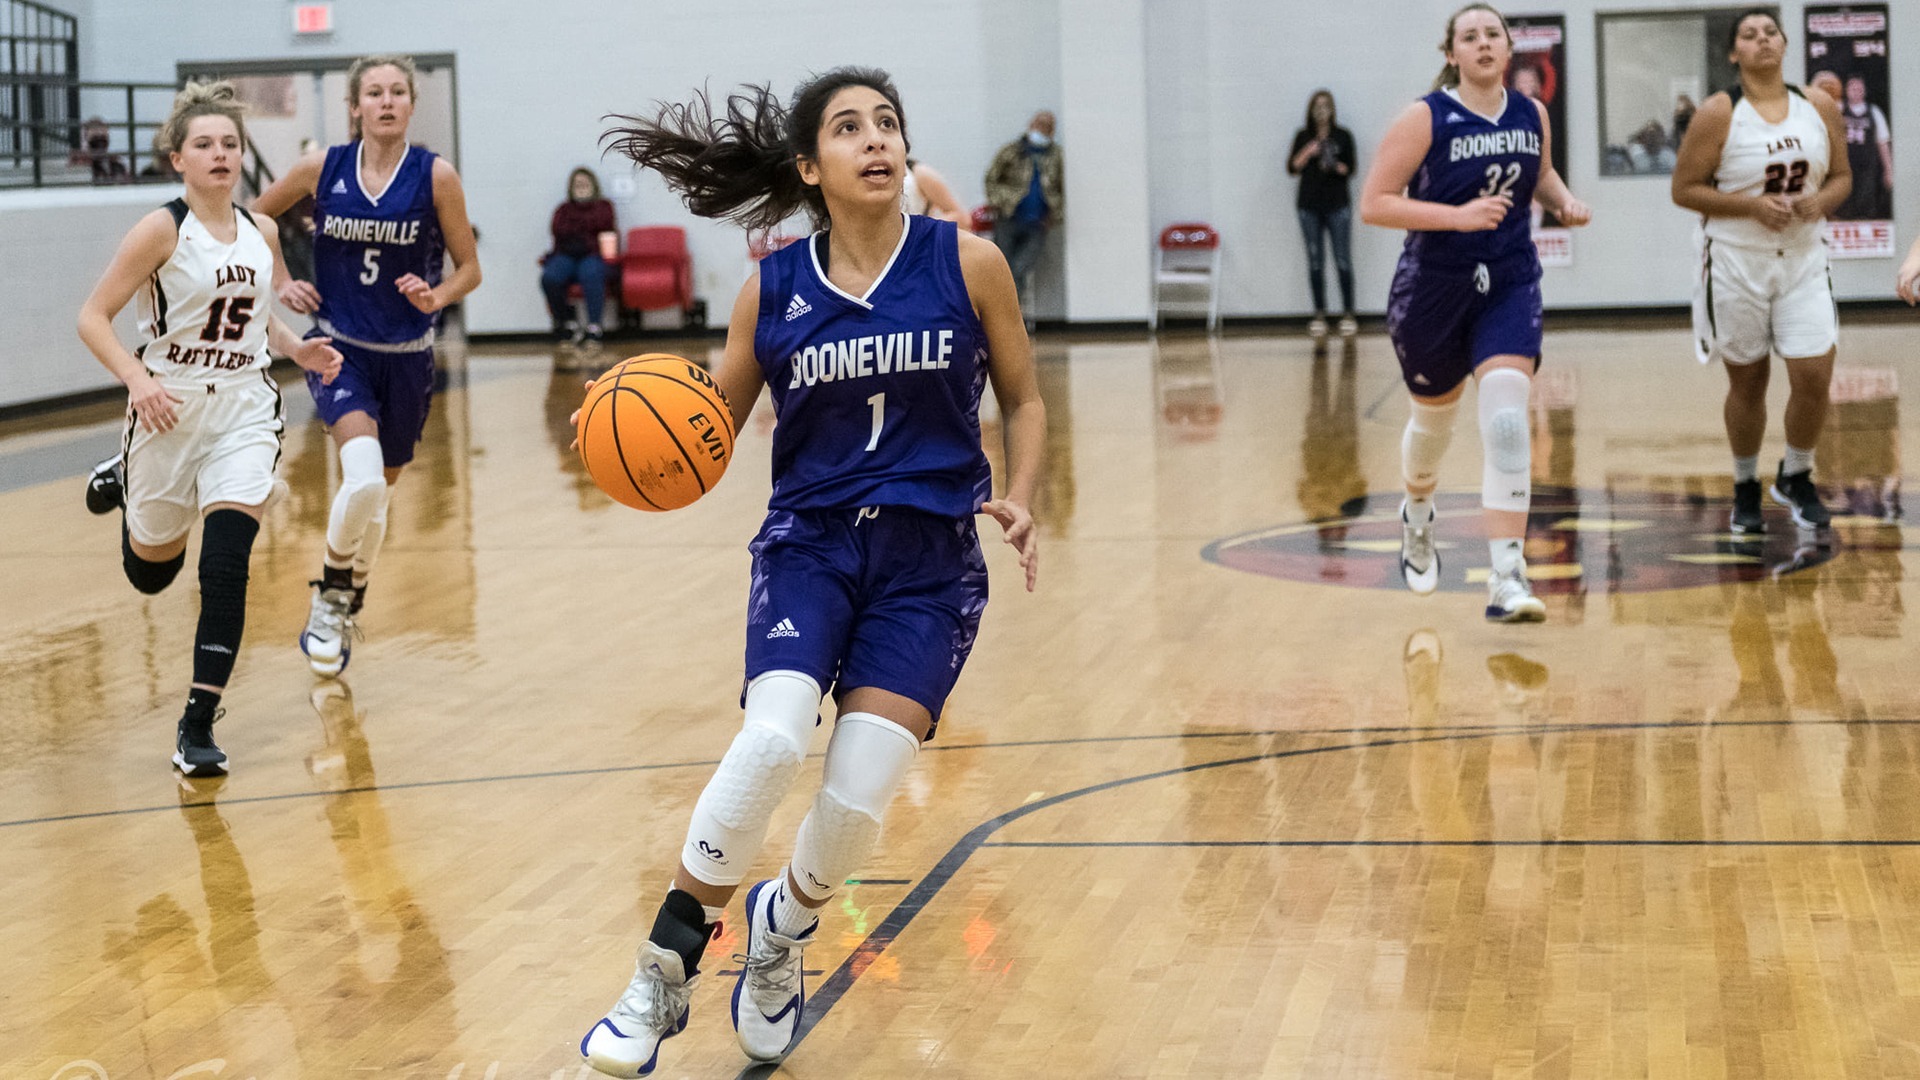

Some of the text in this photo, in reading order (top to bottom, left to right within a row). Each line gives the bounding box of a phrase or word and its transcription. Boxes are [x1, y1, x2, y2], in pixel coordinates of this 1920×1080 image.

[1450, 129, 1540, 162] BOONEVILLE
[1766, 136, 1803, 155] LADY
[1479, 161, 1522, 198] 32
[1763, 160, 1809, 195] 22
[324, 215, 420, 245] BOONEVILLE
[216, 265, 256, 288] LADY
[359, 248, 381, 286] 5
[199, 296, 255, 342] 15
[785, 304, 813, 322] adidas
[789, 330, 953, 390] BOONEVILLE
[864, 392, 886, 452] 1
[766, 629, 800, 639] adidas
